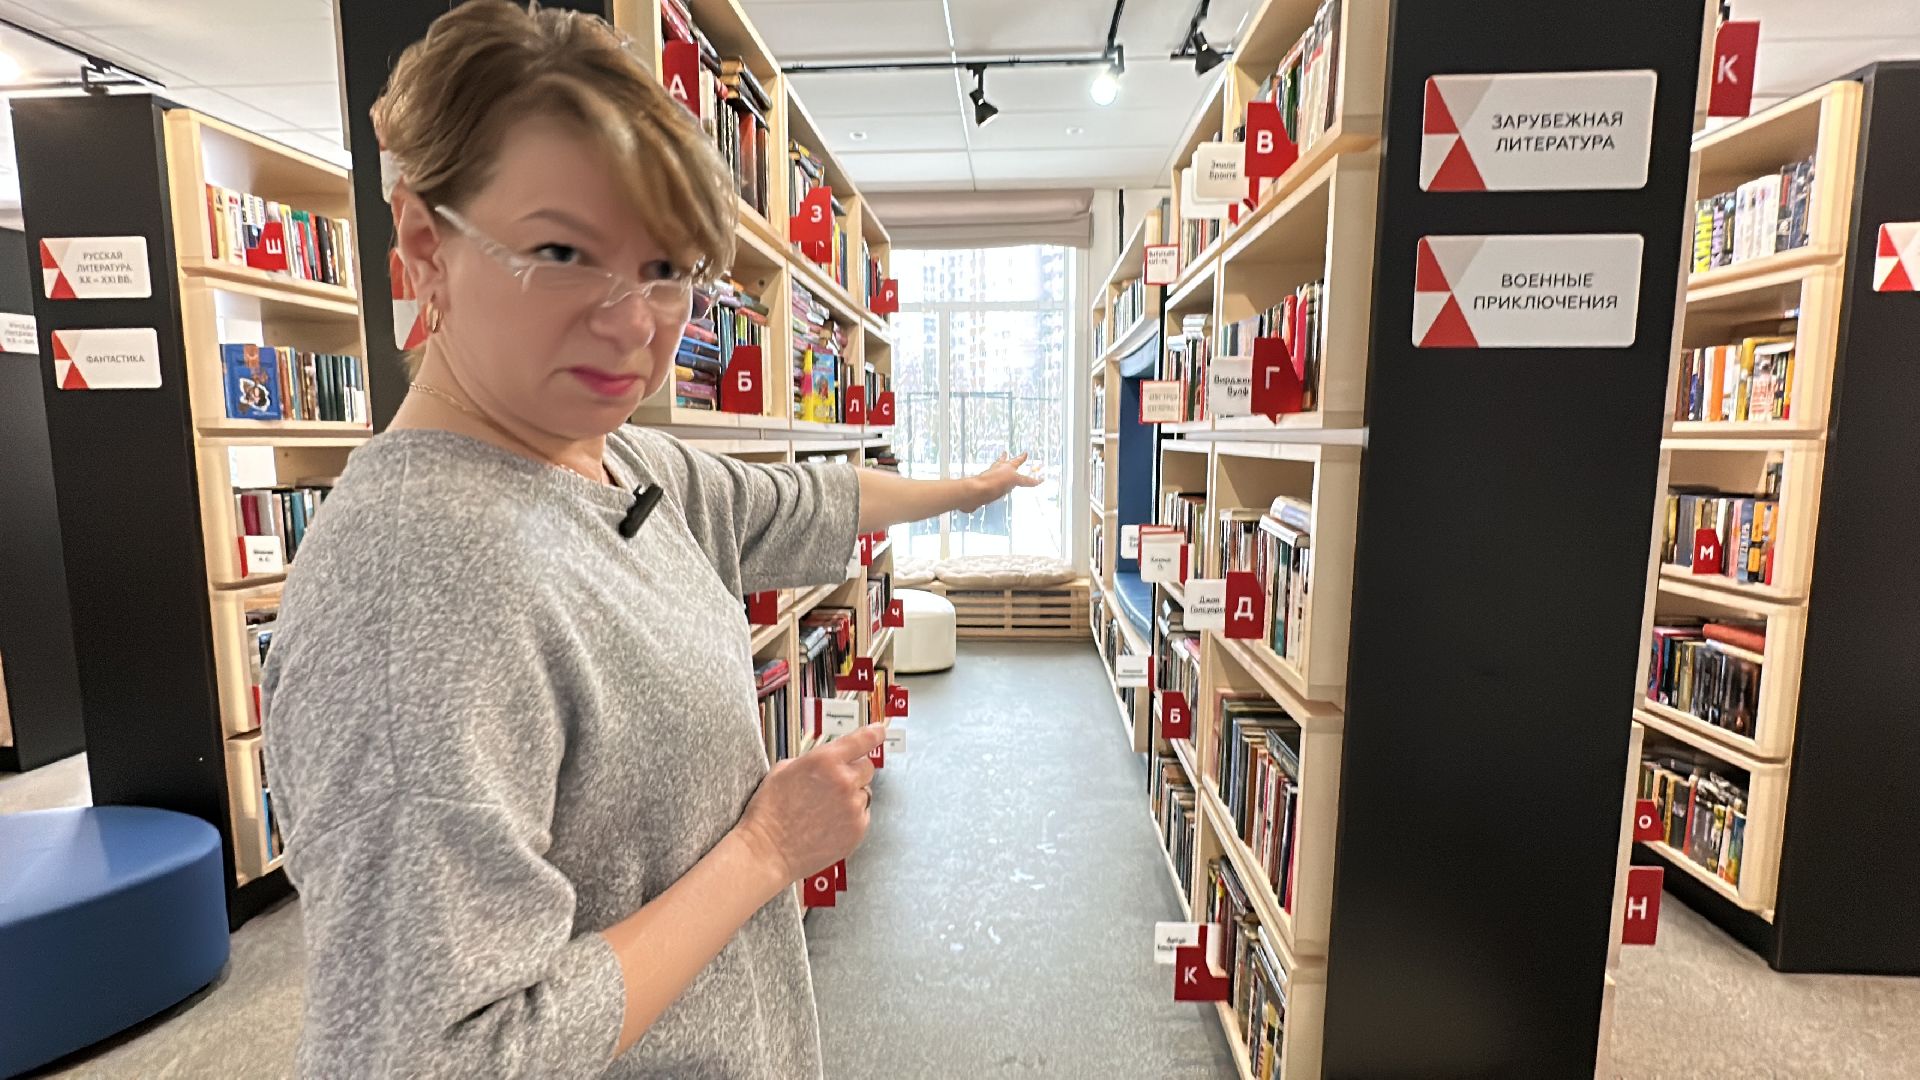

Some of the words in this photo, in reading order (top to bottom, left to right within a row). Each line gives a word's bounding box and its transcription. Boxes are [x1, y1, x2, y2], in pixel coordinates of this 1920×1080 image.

[1717, 54, 1738, 84] К
[669, 73, 688, 100] А
[1491, 111, 1624, 130] ЗАРУБЕЖНАЯ
[1256, 129, 1274, 154] В
[1495, 134, 1615, 152] ЛИТЕРАТУРА
[810, 204, 823, 223] З
[265, 237, 283, 255] Ш
[83, 251, 123, 261] РУССКАЯ
[76, 262, 133, 273] ЛИТЕРАТУРА
[1501, 272, 1595, 289] ВОЕННЫЕ
[885, 290, 894, 303] Р
[1473, 295, 1618, 311] ПРИКЛЮЧЕНИЯ
[86, 354, 145, 365] ФАНТАСТИКА
[737, 371, 753, 392] Б
[1265, 366, 1280, 390] Г
[849, 399, 859, 413] Л
[881, 404, 890, 416] С
[1700, 544, 1714, 561] М
[1233, 596, 1254, 621] Д
[857, 668, 868, 681] Н
[894, 698, 906, 709] Ю
[1169, 707, 1181, 724] Б
[1638, 815, 1652, 829] О
[814, 876, 828, 892] О
[1627, 896, 1648, 920] Н
[1184, 966, 1198, 985] К
